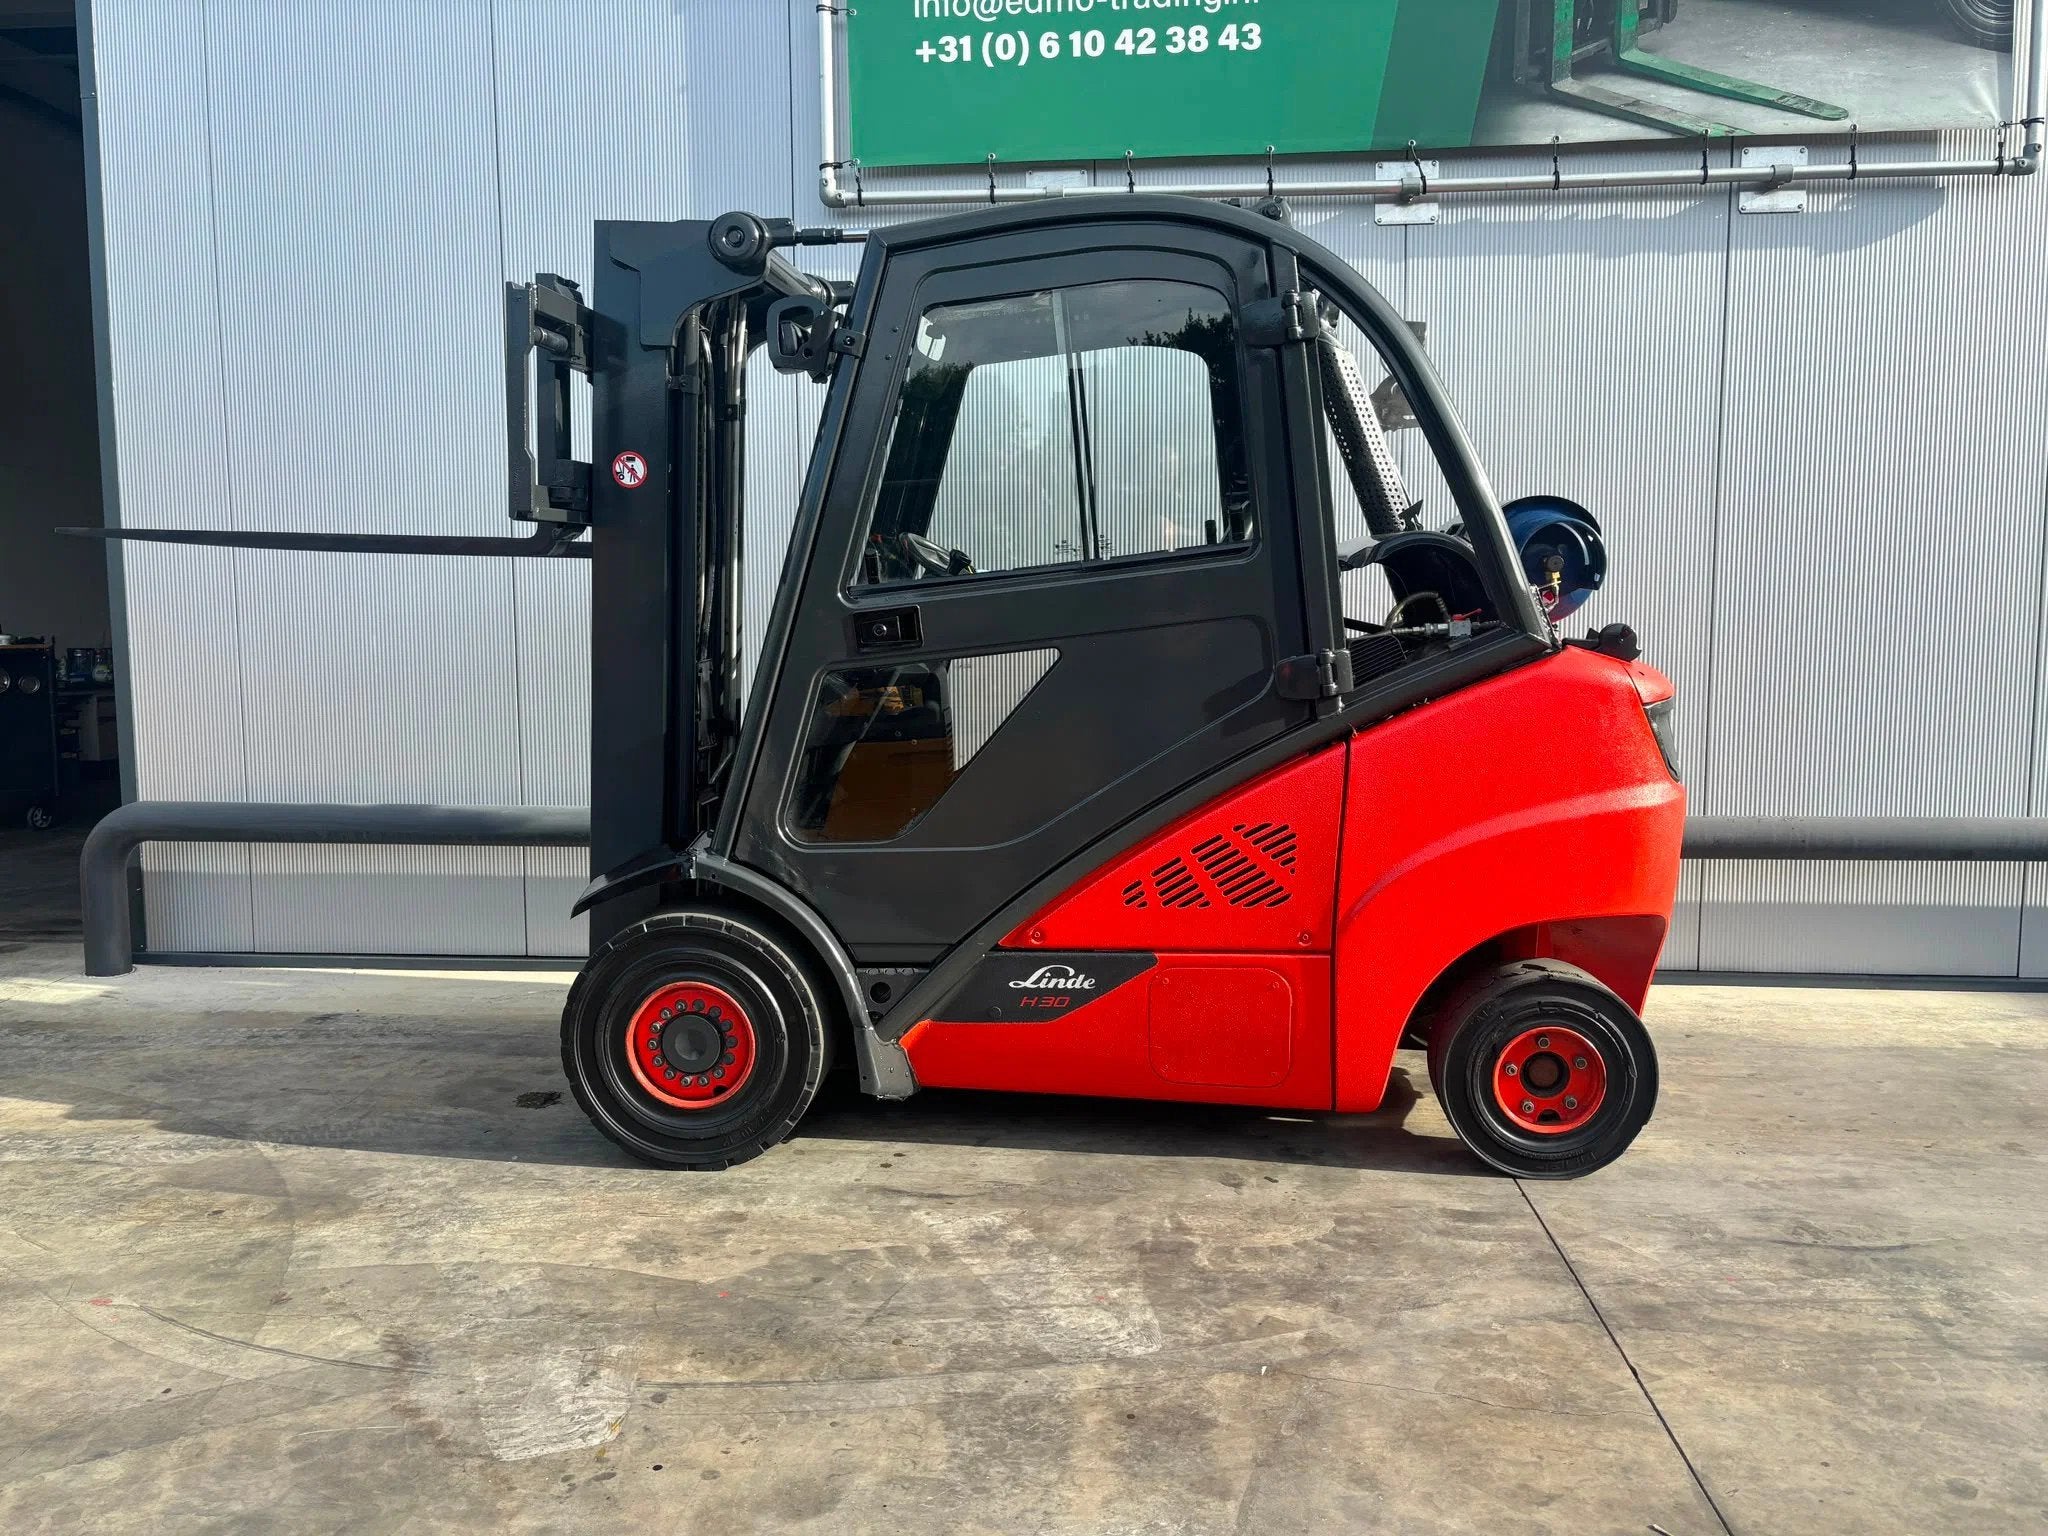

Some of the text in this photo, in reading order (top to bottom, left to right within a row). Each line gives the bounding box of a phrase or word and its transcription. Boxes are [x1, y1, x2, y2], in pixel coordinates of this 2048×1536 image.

[915, 0, 1259, 21] info@emo-g.
[915, 23, 1262, 67] +31 (0) 6 10 42 38 43
[1008, 965, 1096, 989] Linde
